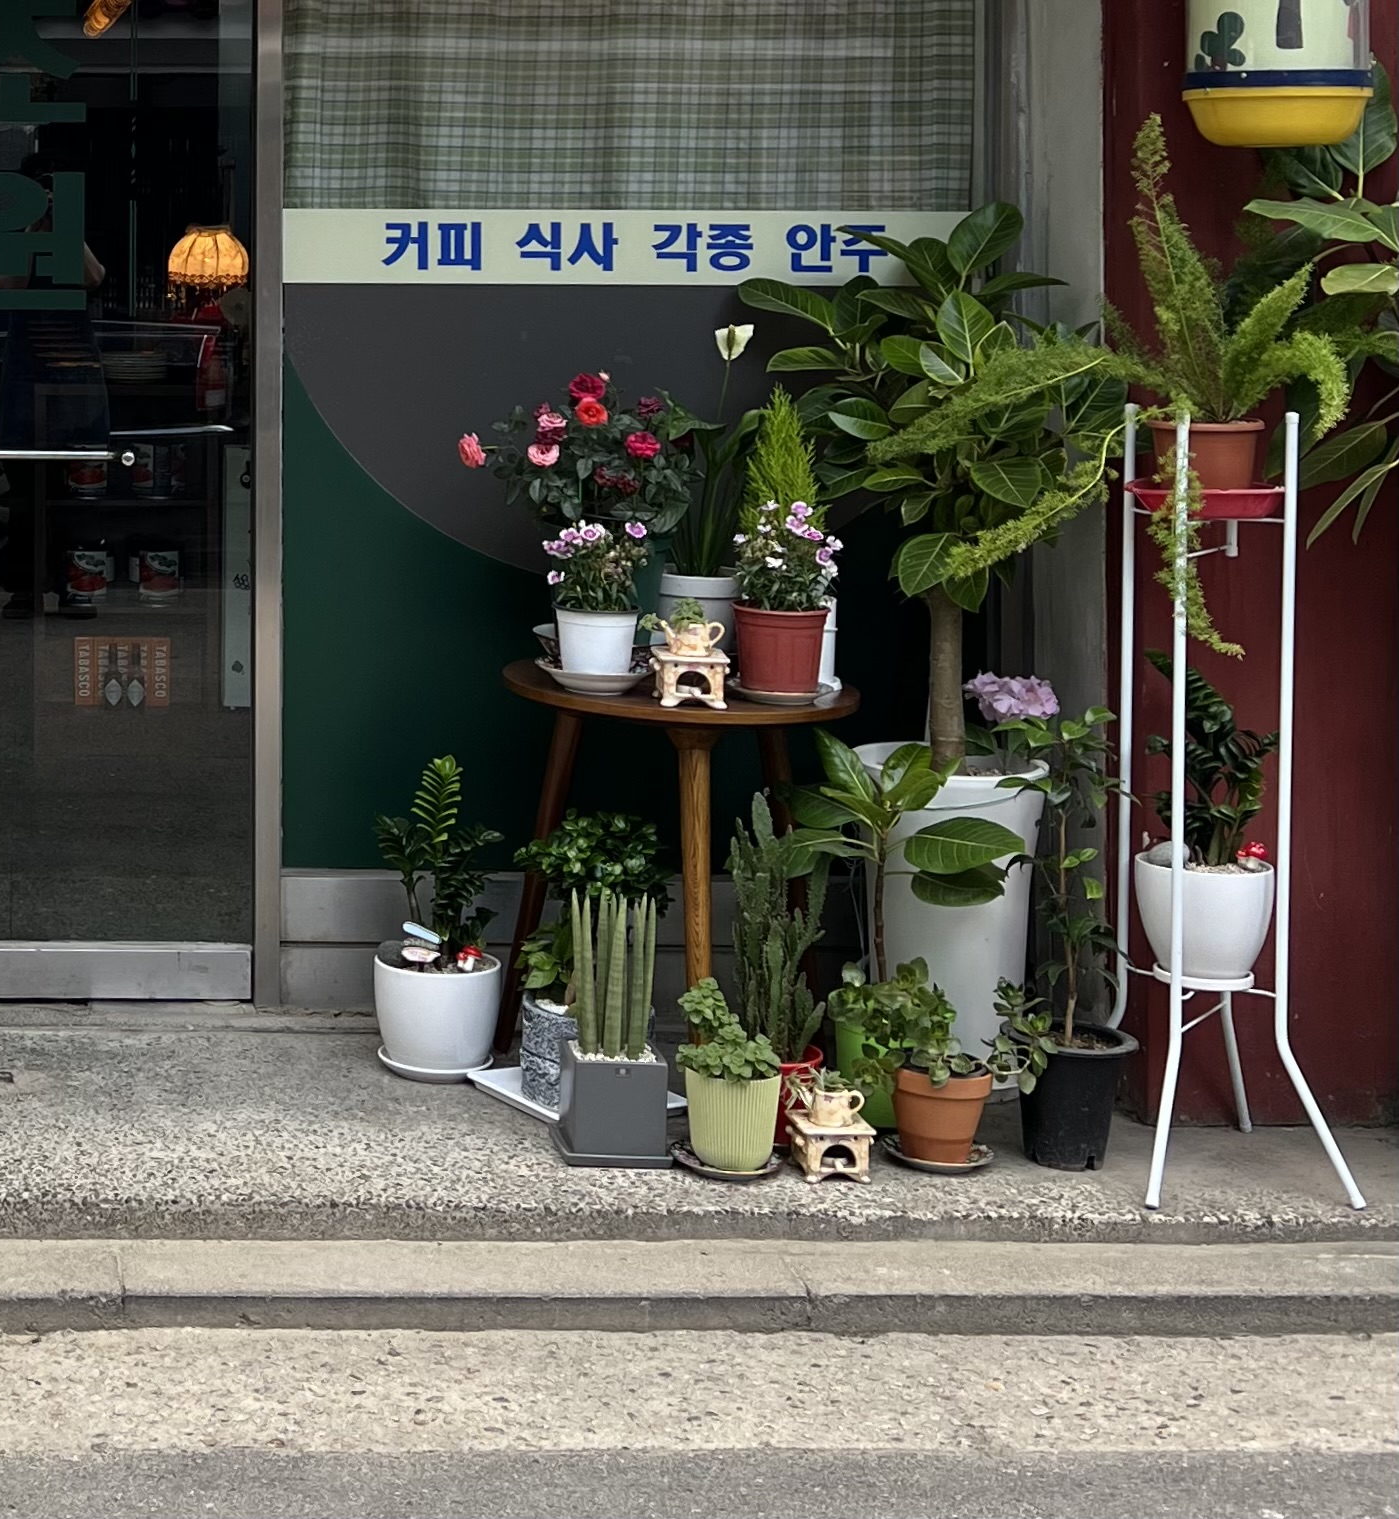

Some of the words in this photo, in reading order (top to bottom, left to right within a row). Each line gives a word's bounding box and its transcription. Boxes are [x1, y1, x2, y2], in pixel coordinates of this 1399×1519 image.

[381, 221, 482, 271] 커피
[515, 222, 618, 272] 식사
[651, 222, 754, 272] 각종
[786, 223, 889, 274] 안주
[78, 644, 90, 697] TABASCO
[154, 645, 167, 698] TABASCO
